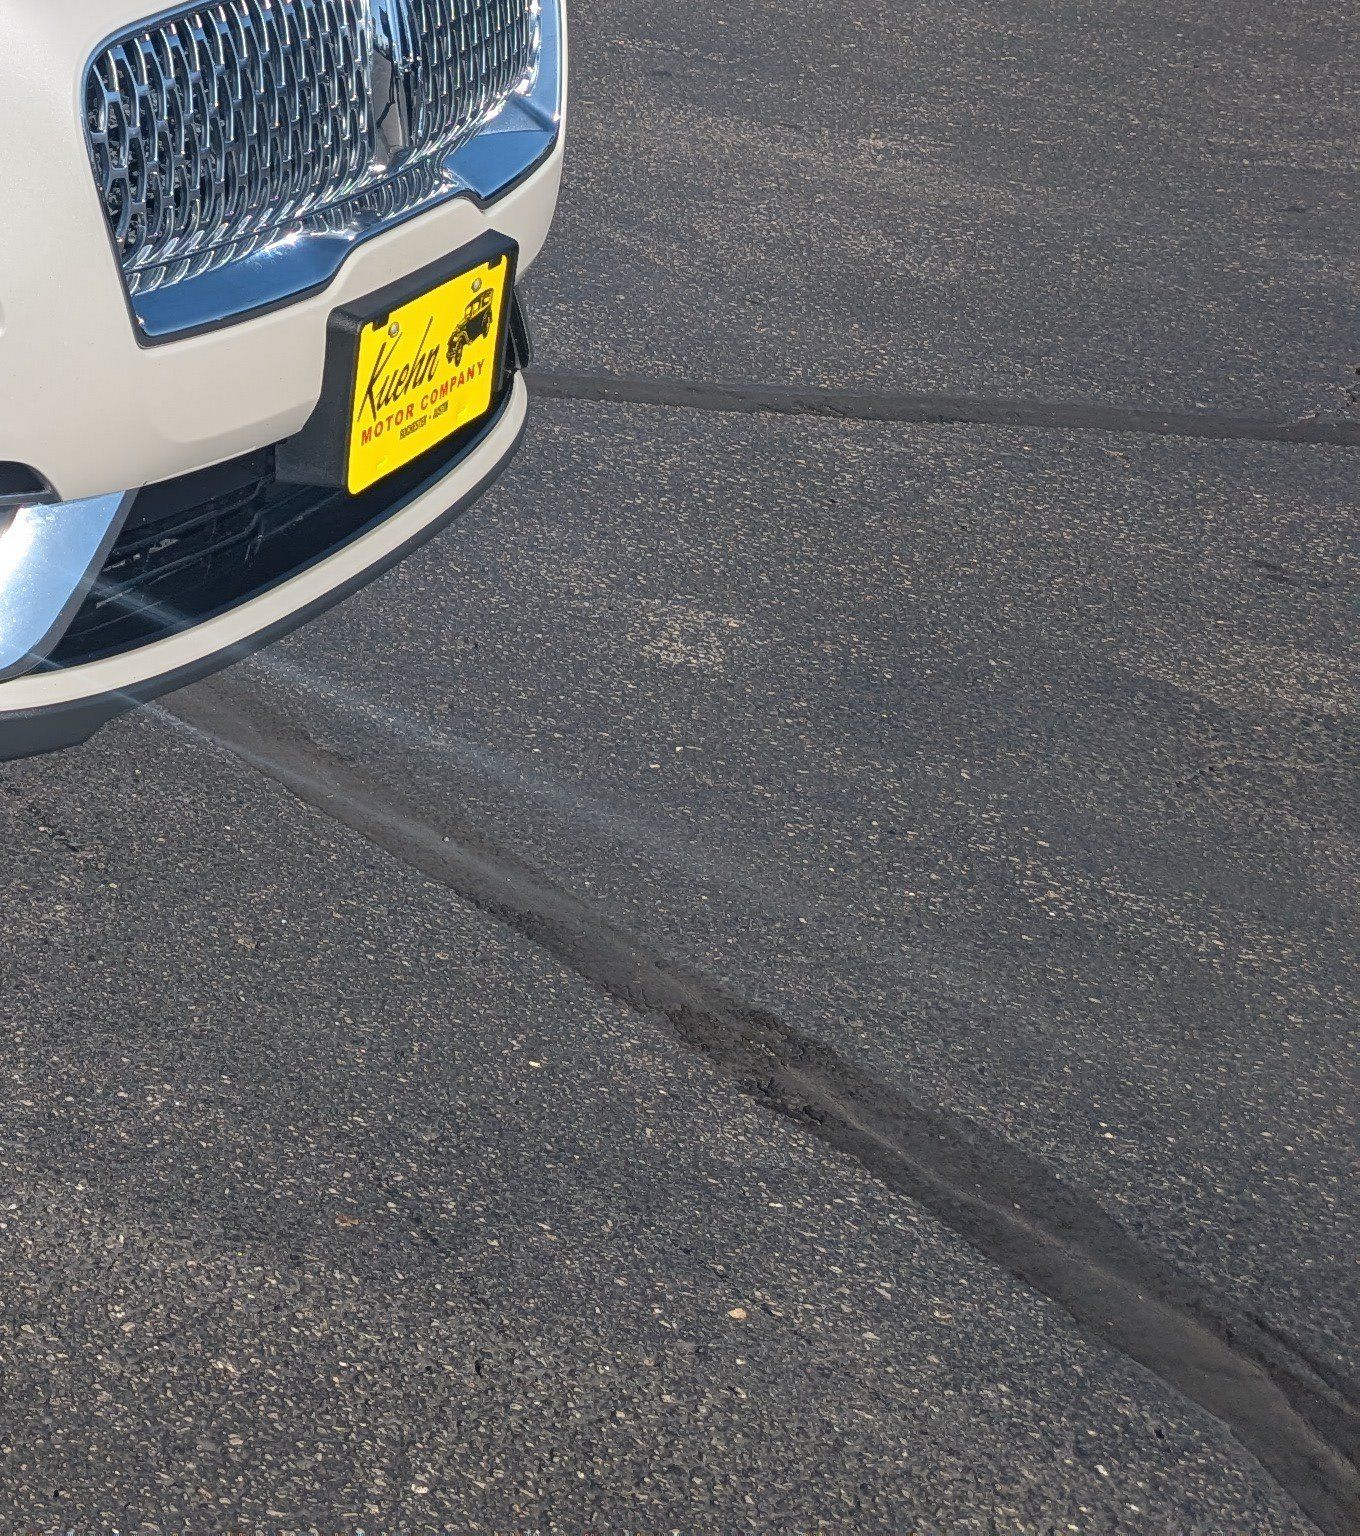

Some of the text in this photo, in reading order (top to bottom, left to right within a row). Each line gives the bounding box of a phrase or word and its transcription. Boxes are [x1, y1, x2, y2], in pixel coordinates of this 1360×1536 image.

[357, 316, 440, 422] Kuehn
[360, 358, 486, 446] MOTOR COMPANY
